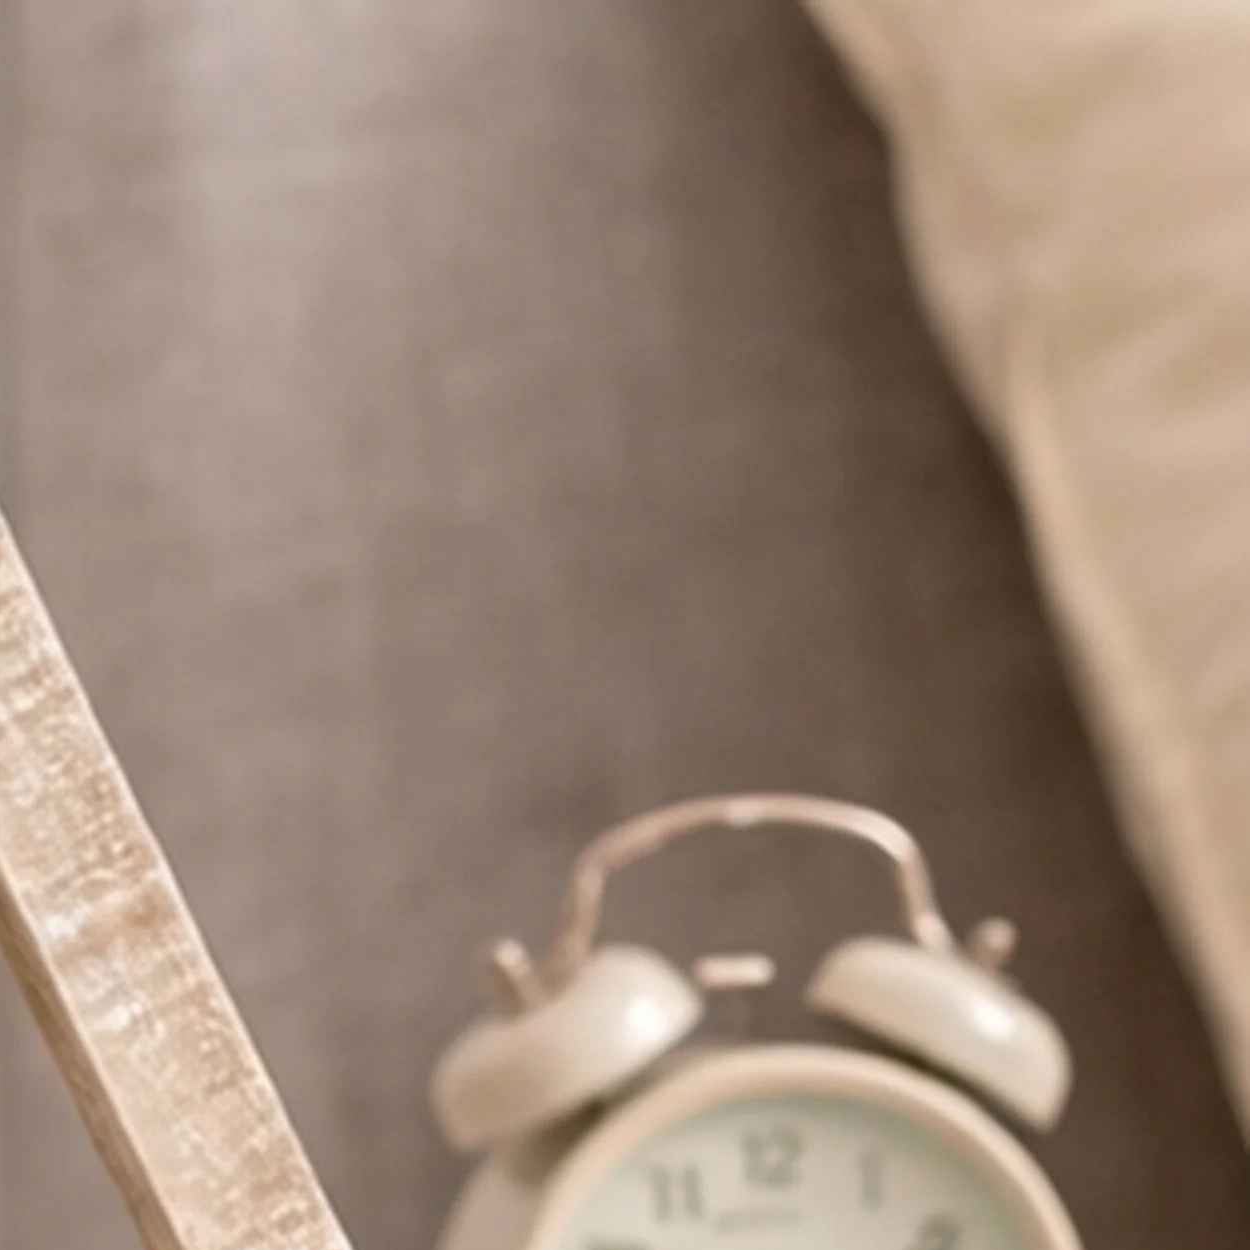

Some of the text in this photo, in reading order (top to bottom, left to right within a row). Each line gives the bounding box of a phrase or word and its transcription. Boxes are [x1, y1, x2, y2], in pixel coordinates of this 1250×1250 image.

[743, 1126, 803, 1188] 12
[859, 1144, 886, 1209] 1
[650, 1164, 704, 1223] 11
